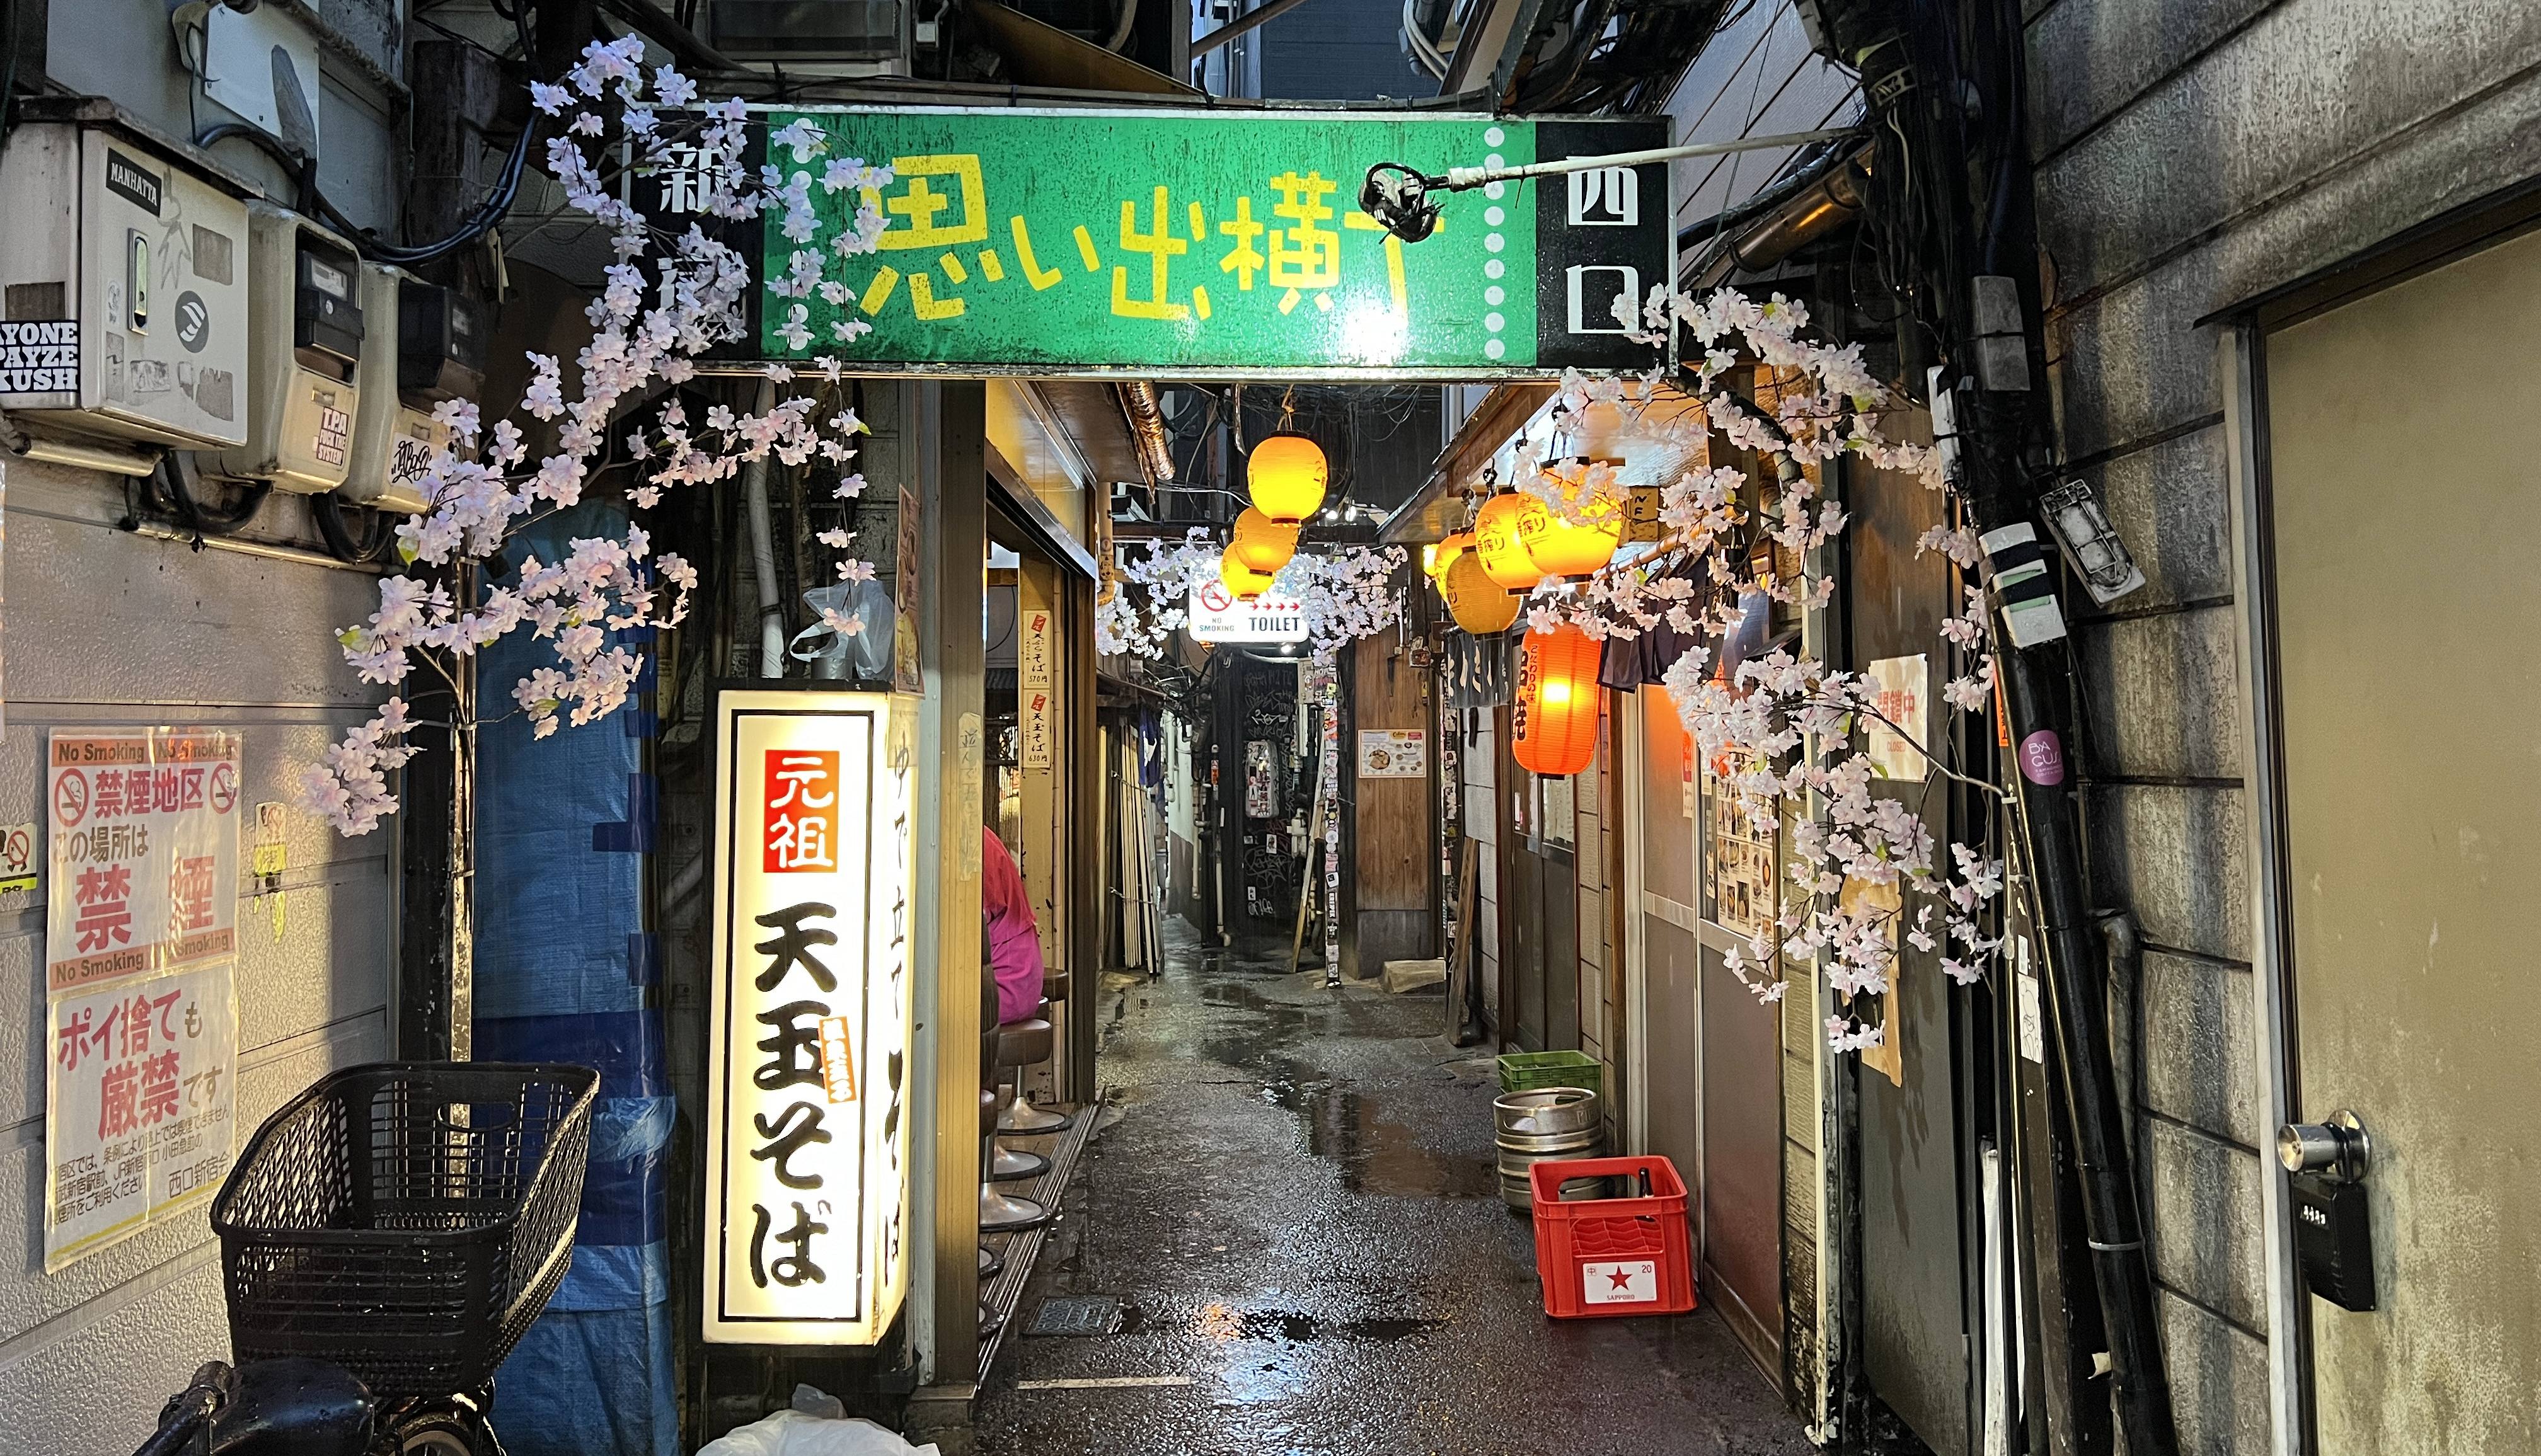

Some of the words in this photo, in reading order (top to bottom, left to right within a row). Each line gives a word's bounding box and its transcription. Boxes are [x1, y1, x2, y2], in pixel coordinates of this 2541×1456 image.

[111, 163, 158, 206] MANHATTA
[1566, 156, 1639, 334] 西口
[0, 323, 78, 345] YONE
[1248, 617, 1300, 631] TOILET
[59, 743, 79, 761] No
[84, 742, 144, 762] Smoking
[1887, 741, 1906, 752] CLOSED
[95, 767, 205, 818] 禁煙地区
[769, 757, 834, 869] 元祖
[56, 961, 76, 983] No
[81, 952, 144, 978] Smoking
[750, 901, 838, 1289] 天玉そば
[1641, 1264, 1652, 1273] 20
